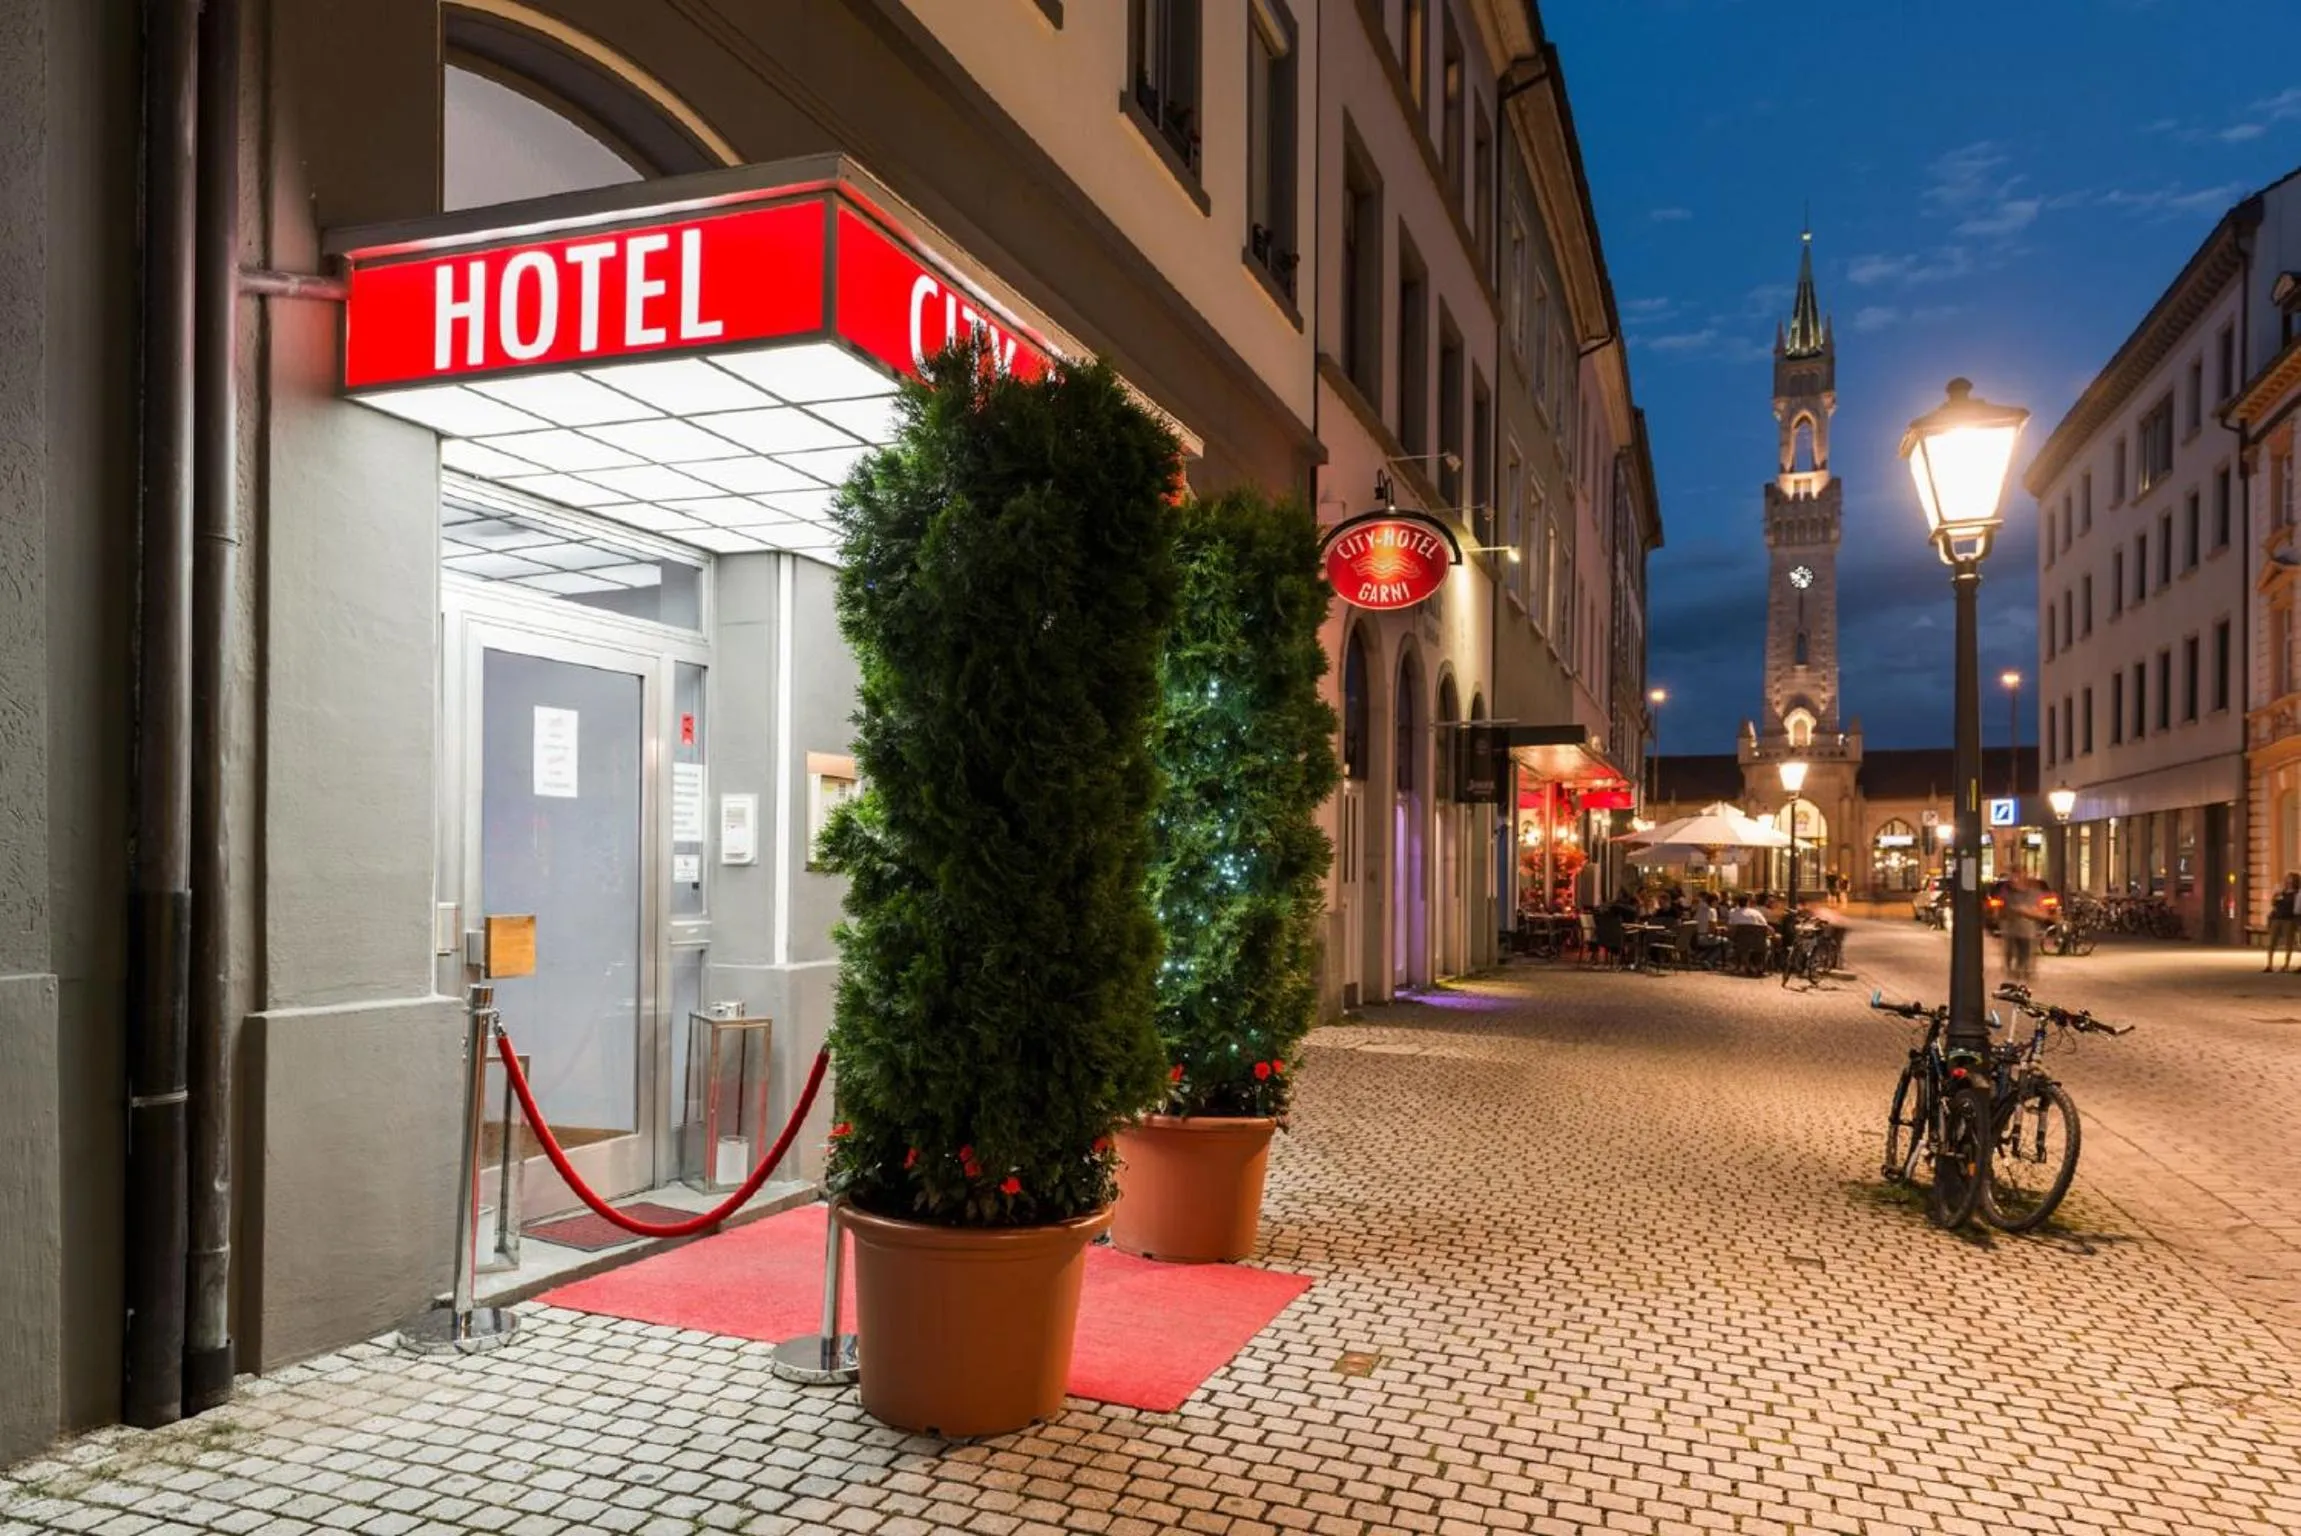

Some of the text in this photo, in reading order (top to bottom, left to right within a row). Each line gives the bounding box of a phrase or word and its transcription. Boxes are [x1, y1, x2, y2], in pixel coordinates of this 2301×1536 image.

[434, 228, 723, 370] HOTEL
[1336, 527, 1439, 559] CITY-HOTEL
[1358, 582, 1411, 603] GARNI
